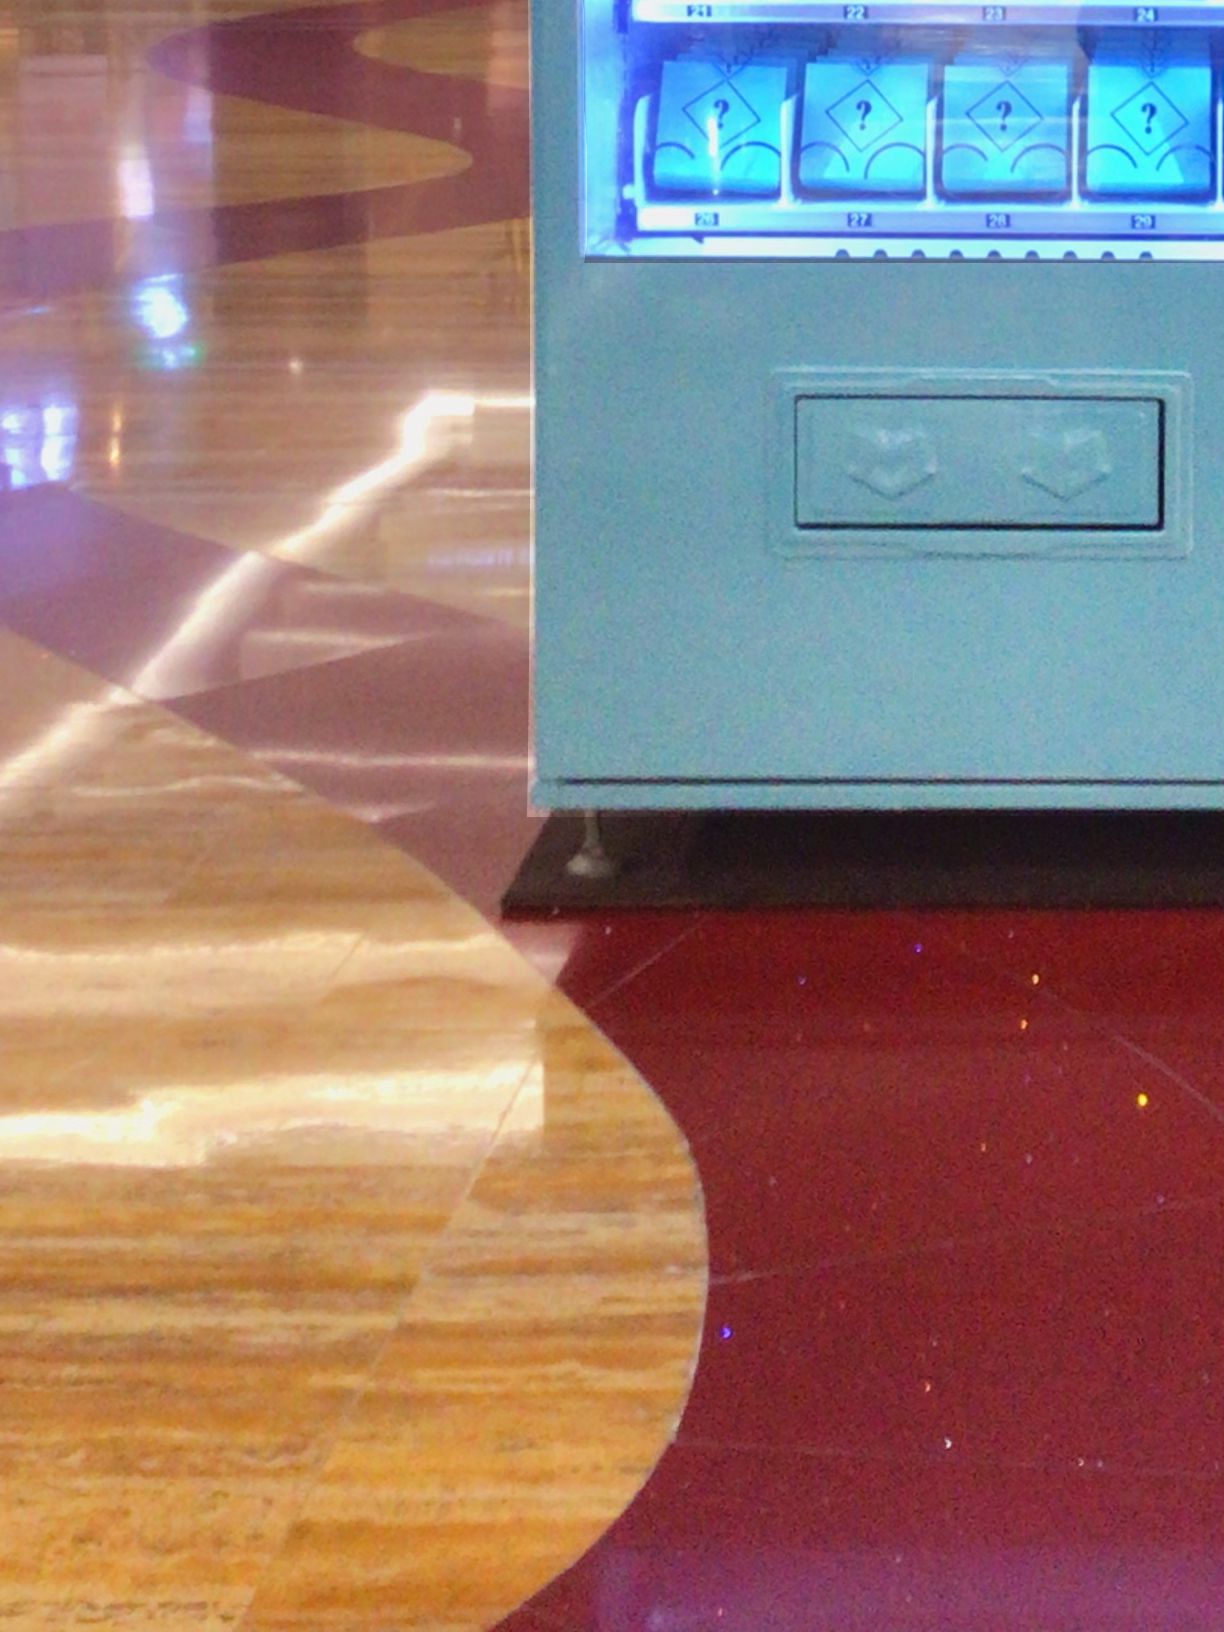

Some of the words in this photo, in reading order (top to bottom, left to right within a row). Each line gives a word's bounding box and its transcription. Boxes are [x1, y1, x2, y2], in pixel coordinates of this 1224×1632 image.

[846, 5, 866, 19] 22
[1137, 7, 1155, 22] 24
[849, 213, 869, 227] 27
